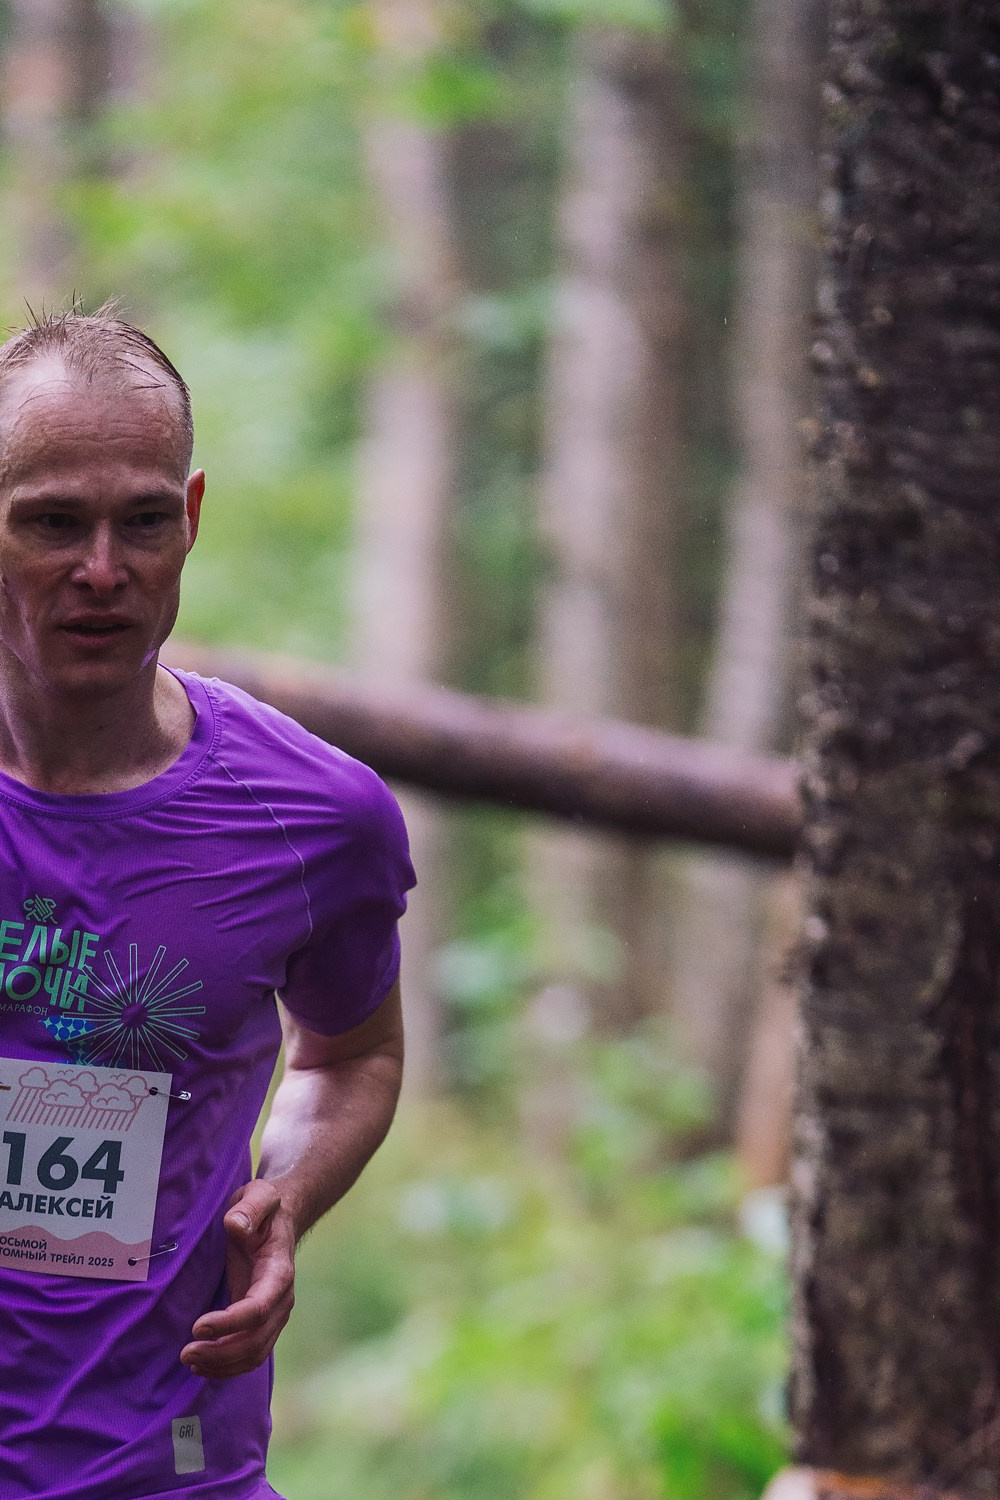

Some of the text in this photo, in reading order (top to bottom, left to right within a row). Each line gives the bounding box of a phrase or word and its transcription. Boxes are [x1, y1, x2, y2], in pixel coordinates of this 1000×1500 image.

[3, 1131, 125, 1193] 164
[50, 1252, 84, 1265] ТРЕЙЛ
[88, 1256, 114, 1267] 2025
